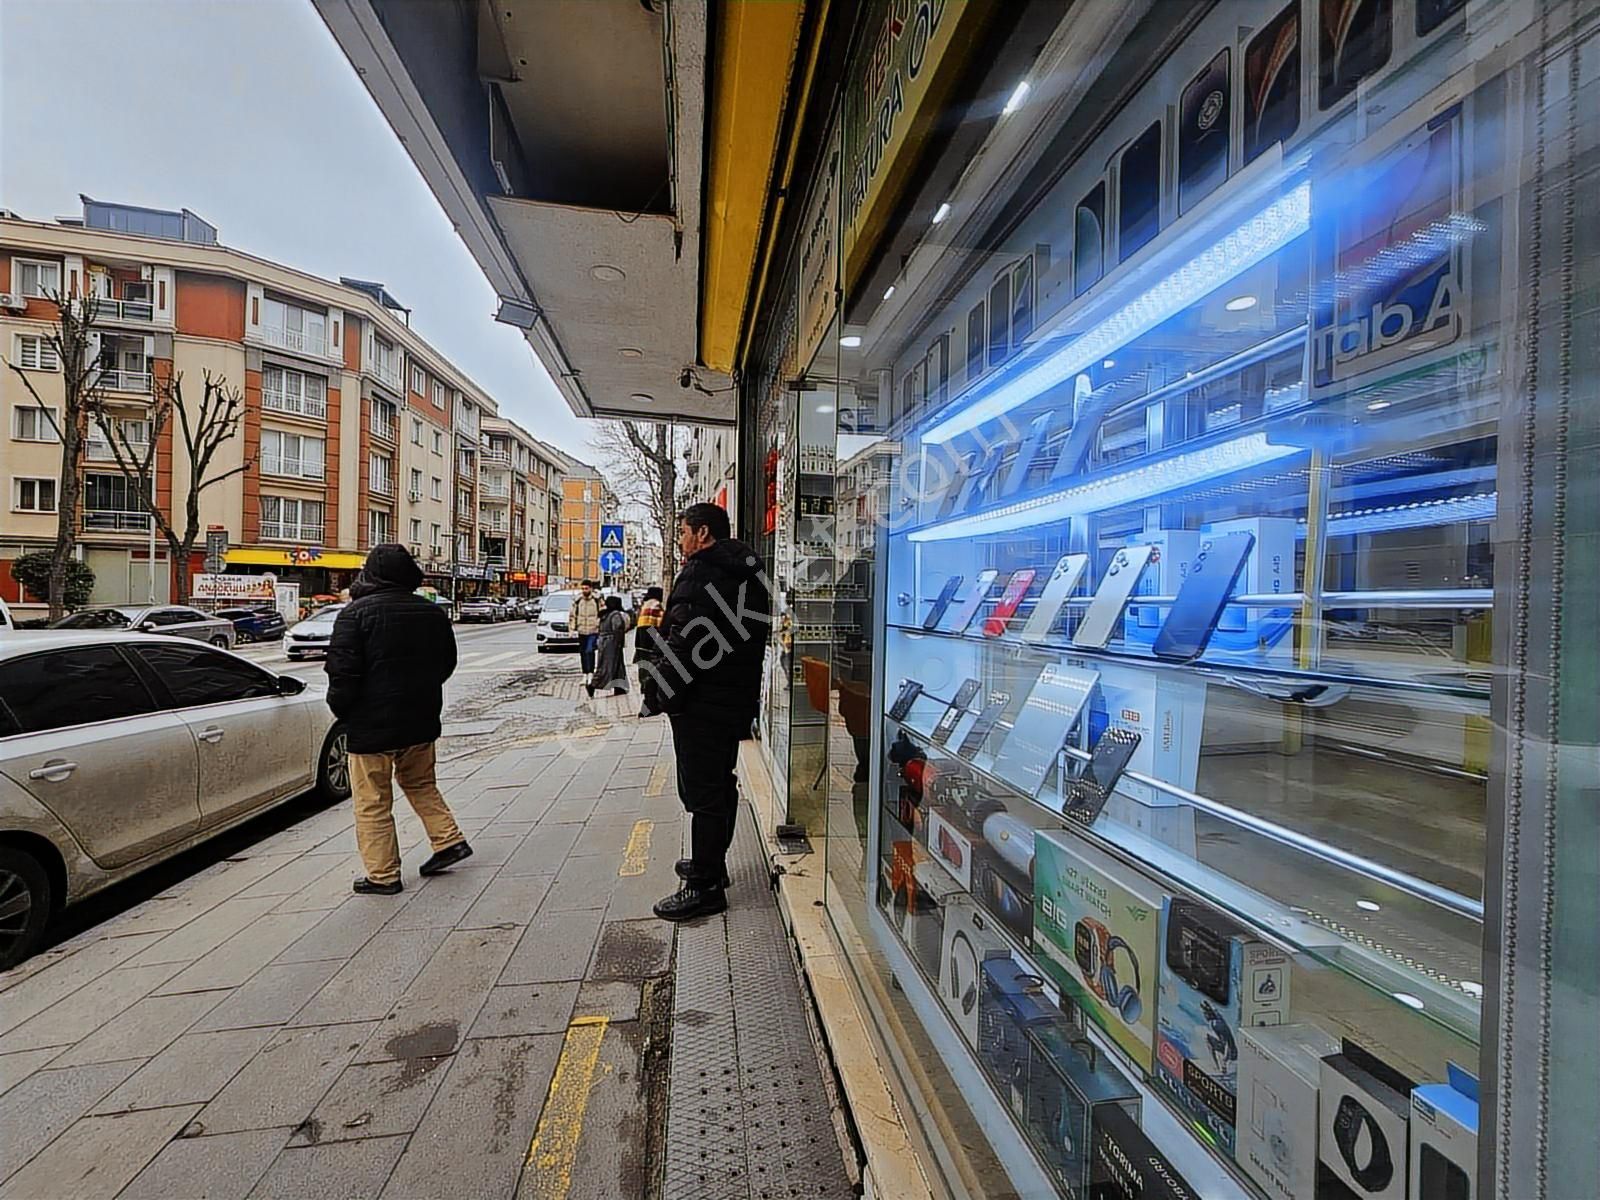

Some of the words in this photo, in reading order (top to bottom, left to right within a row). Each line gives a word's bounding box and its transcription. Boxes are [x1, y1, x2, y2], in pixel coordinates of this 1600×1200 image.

[849, 69, 904, 228] FATURA
[1314, 302, 1413, 373] Tab
[1042, 896, 1067, 929] BIG
[1105, 1133, 1145, 1192] TORIMA
